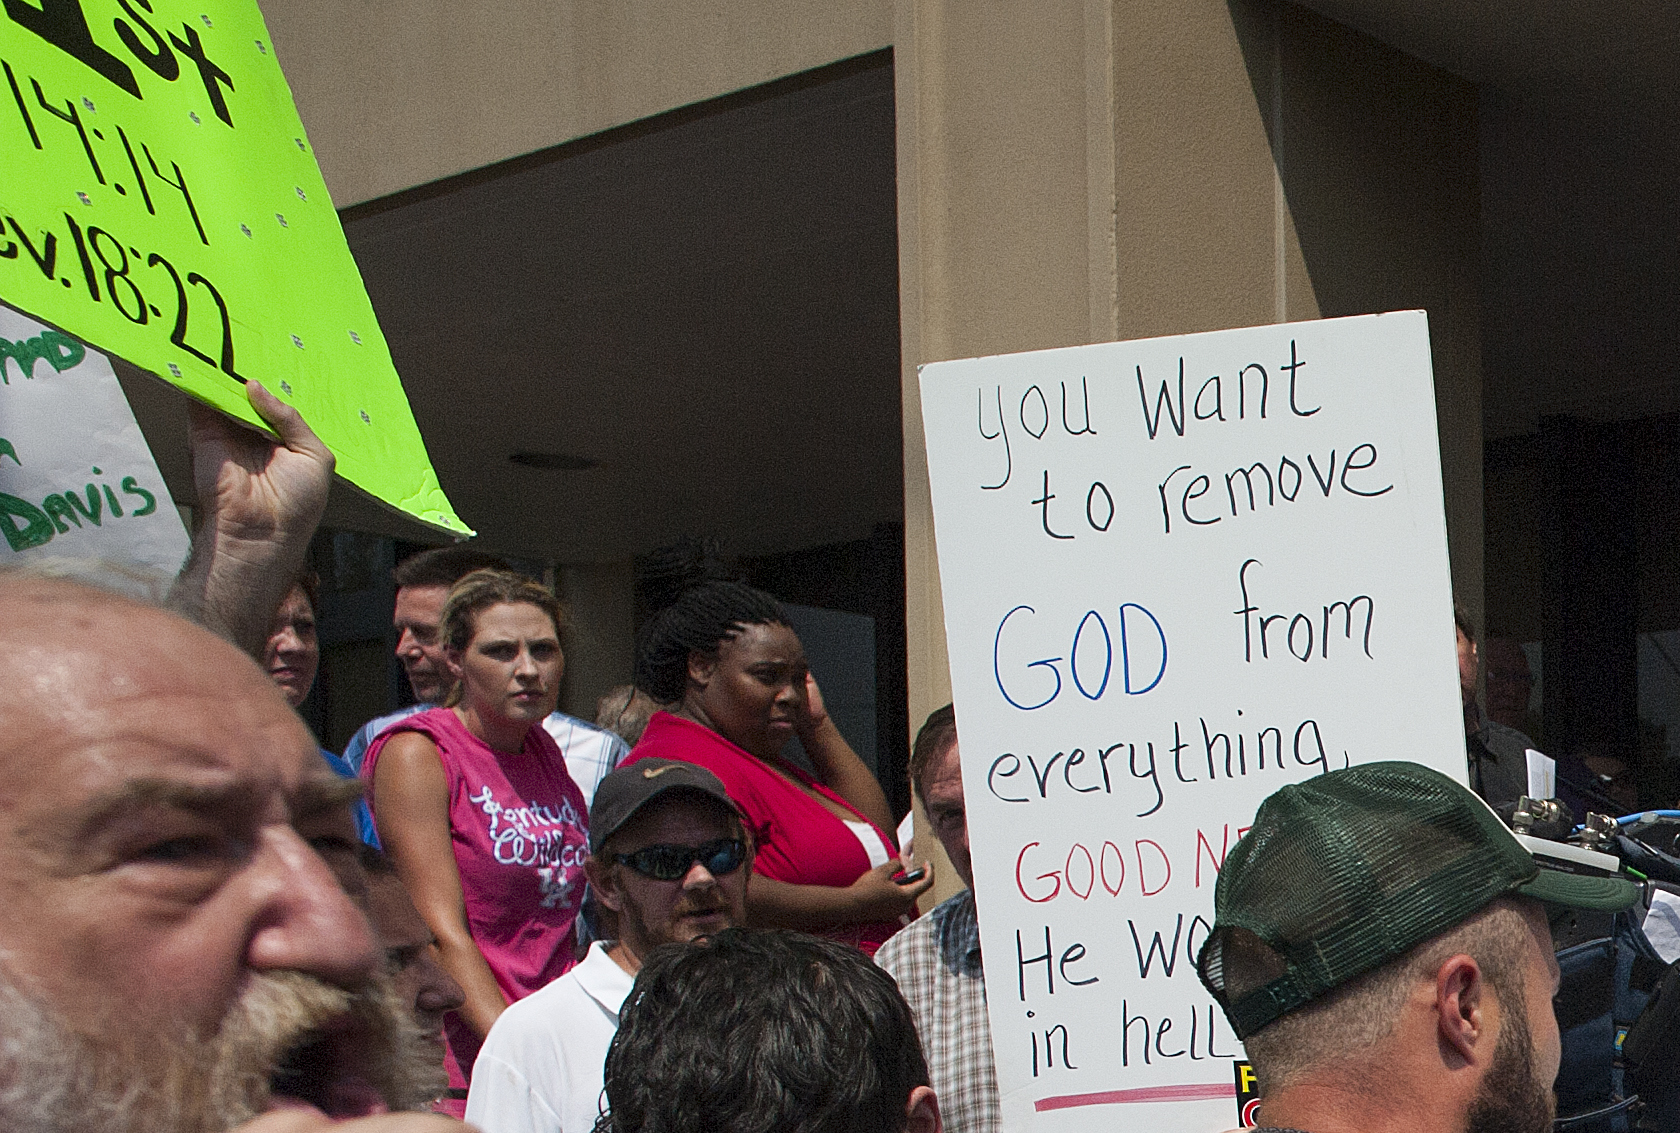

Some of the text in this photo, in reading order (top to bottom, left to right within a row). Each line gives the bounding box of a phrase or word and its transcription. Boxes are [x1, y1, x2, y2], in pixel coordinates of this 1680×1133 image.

[976, 339, 1322, 490] you Want
[1031, 442, 1394, 539] to remove
[993, 558, 1375, 711] GOD from
[1015, 823, 1252, 903] GOOD N
[1015, 925, 1100, 1001] He
[1026, 1010, 1078, 1078] in
